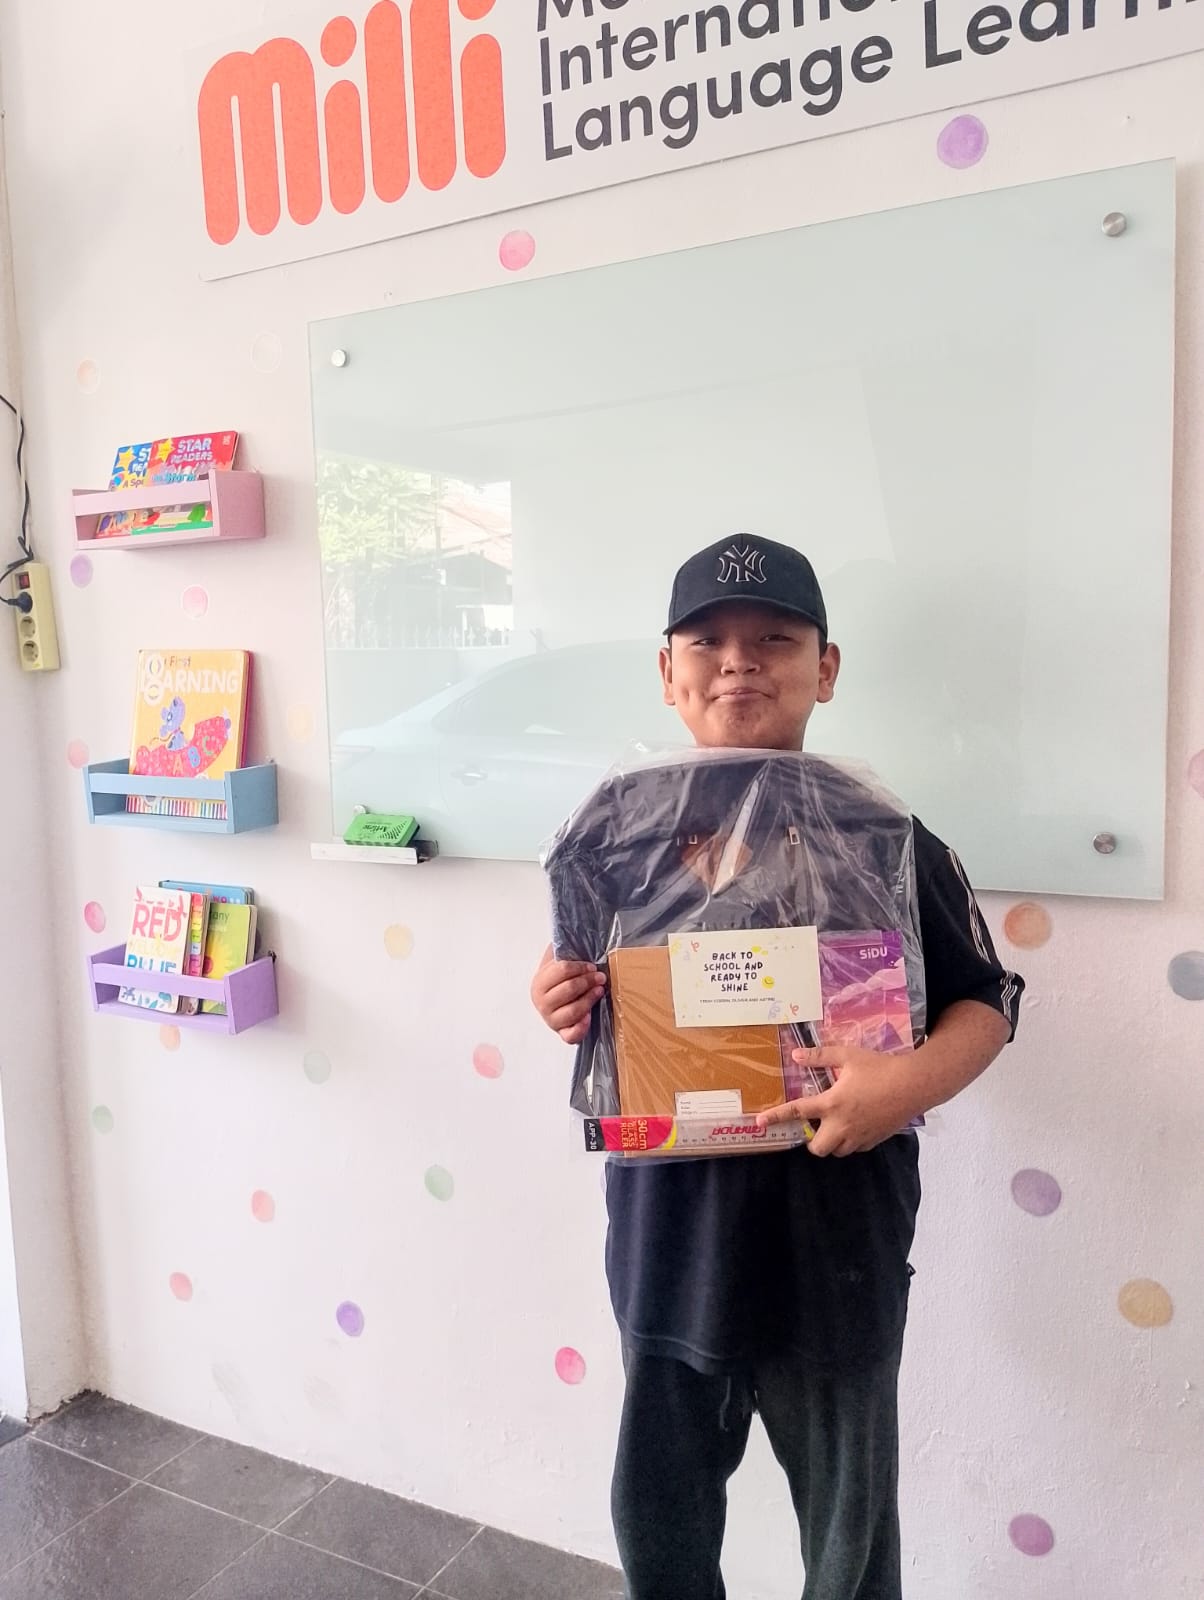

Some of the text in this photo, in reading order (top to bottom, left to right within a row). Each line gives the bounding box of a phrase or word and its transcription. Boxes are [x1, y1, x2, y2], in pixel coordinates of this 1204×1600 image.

[543, 35, 893, 161] Language
[197, 0, 507, 246] milli
[177, 438, 212, 454] STAR
[132, 903, 182, 942] RED
[703, 961, 763, 972] SCHOOL AND
[712, 951, 753, 961] BACK TO
[710, 971, 757, 983] READY TO
[721, 982, 749, 993] SHINE
[588, 1122, 598, 1150] APP-30
[637, 1119, 648, 1150] 30cm
